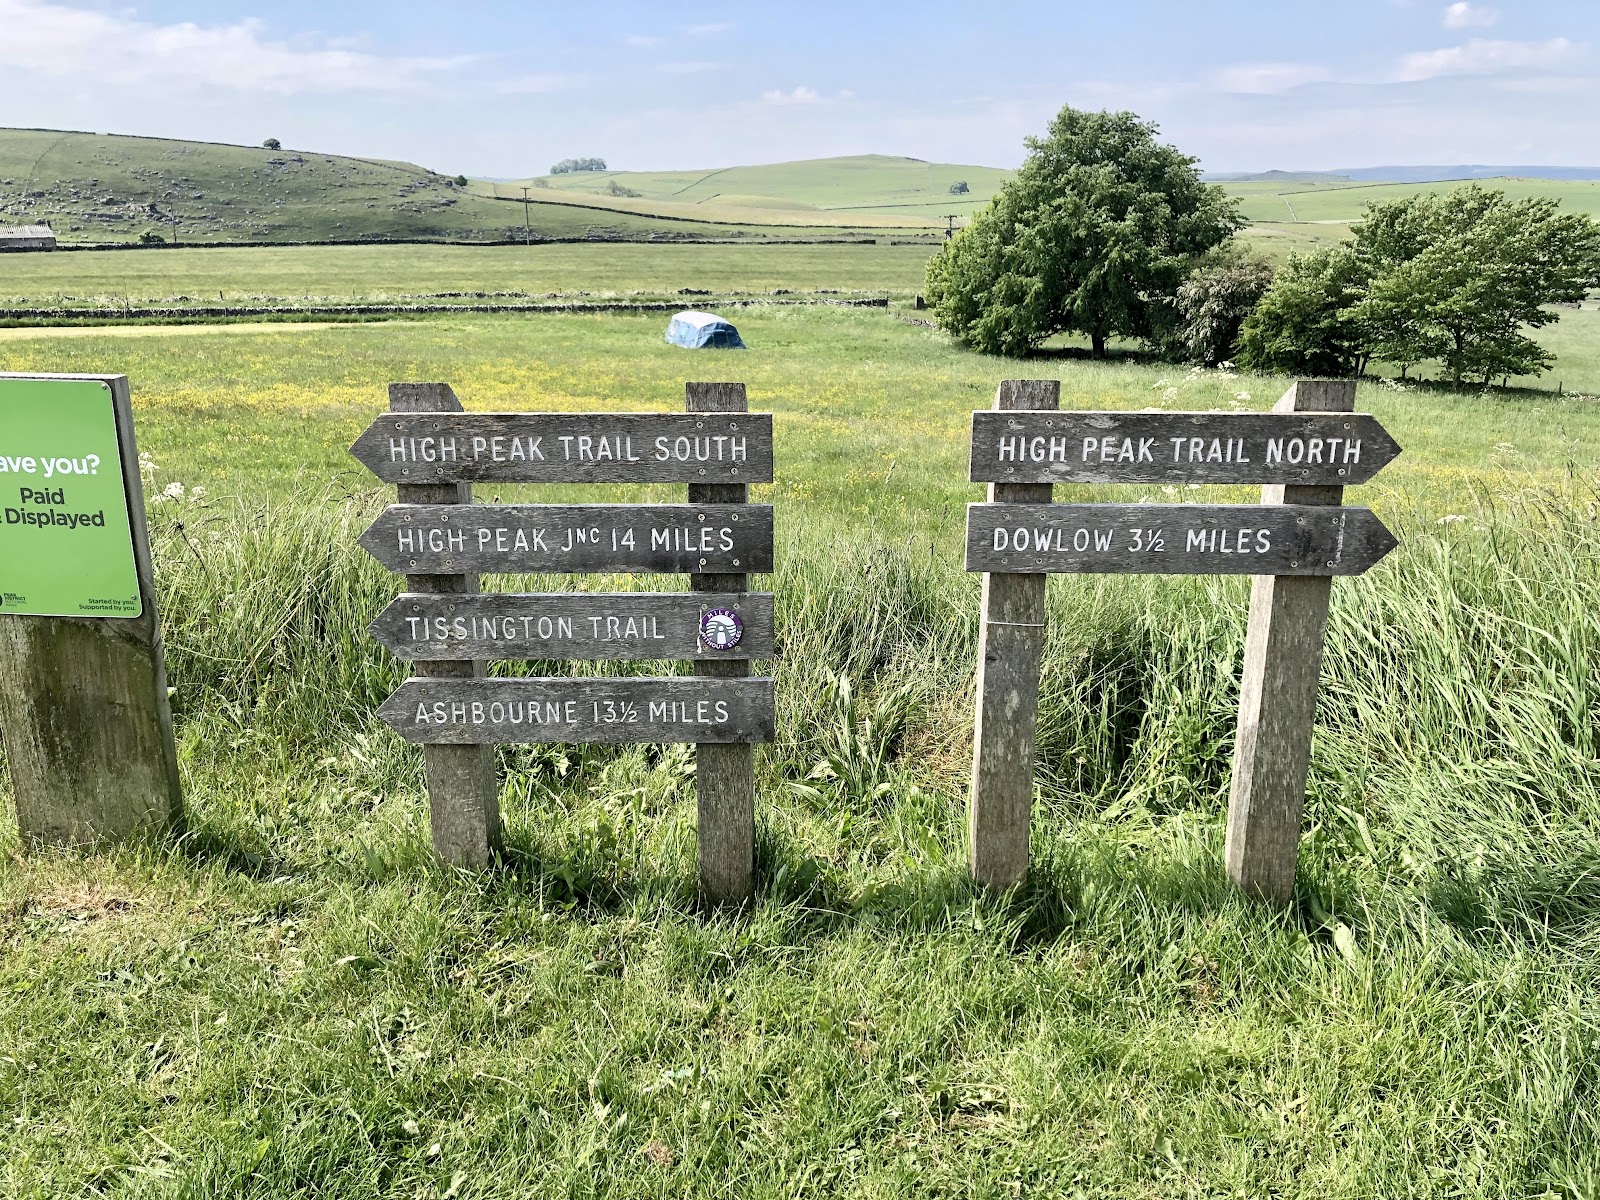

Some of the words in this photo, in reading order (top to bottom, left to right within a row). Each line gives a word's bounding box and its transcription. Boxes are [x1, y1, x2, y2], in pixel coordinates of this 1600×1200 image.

[389, 437, 457, 462] HIGH
[473, 436, 545, 461] PEAK
[558, 436, 640, 461] TRAIL
[654, 436, 748, 461] SOUTH
[996, 436, 1067, 463] HIGH
[1082, 436, 1155, 463] PEAK
[1170, 437, 1250, 463] TRAIL
[1266, 437, 1362, 464] NORTH
[40, 454, 101, 477] you?
[20, 487, 65, 505] Paid
[4, 508, 105, 529] Displayed
[397, 528, 464, 552] HIGH
[478, 528, 547, 552] PEAK
[611, 527, 636, 552] 14
[651, 527, 734, 552] MILES
[993, 528, 1113, 552] DOWLOW
[1186, 528, 1272, 554] MILES
[706, 610, 736, 619] MILES
[406, 616, 573, 641] TISSINGTON
[588, 616, 665, 640] TRAIL
[727, 630, 742, 648] STILES
[415, 703, 577, 724] ASHBOURNE
[649, 701, 729, 723] MILES
